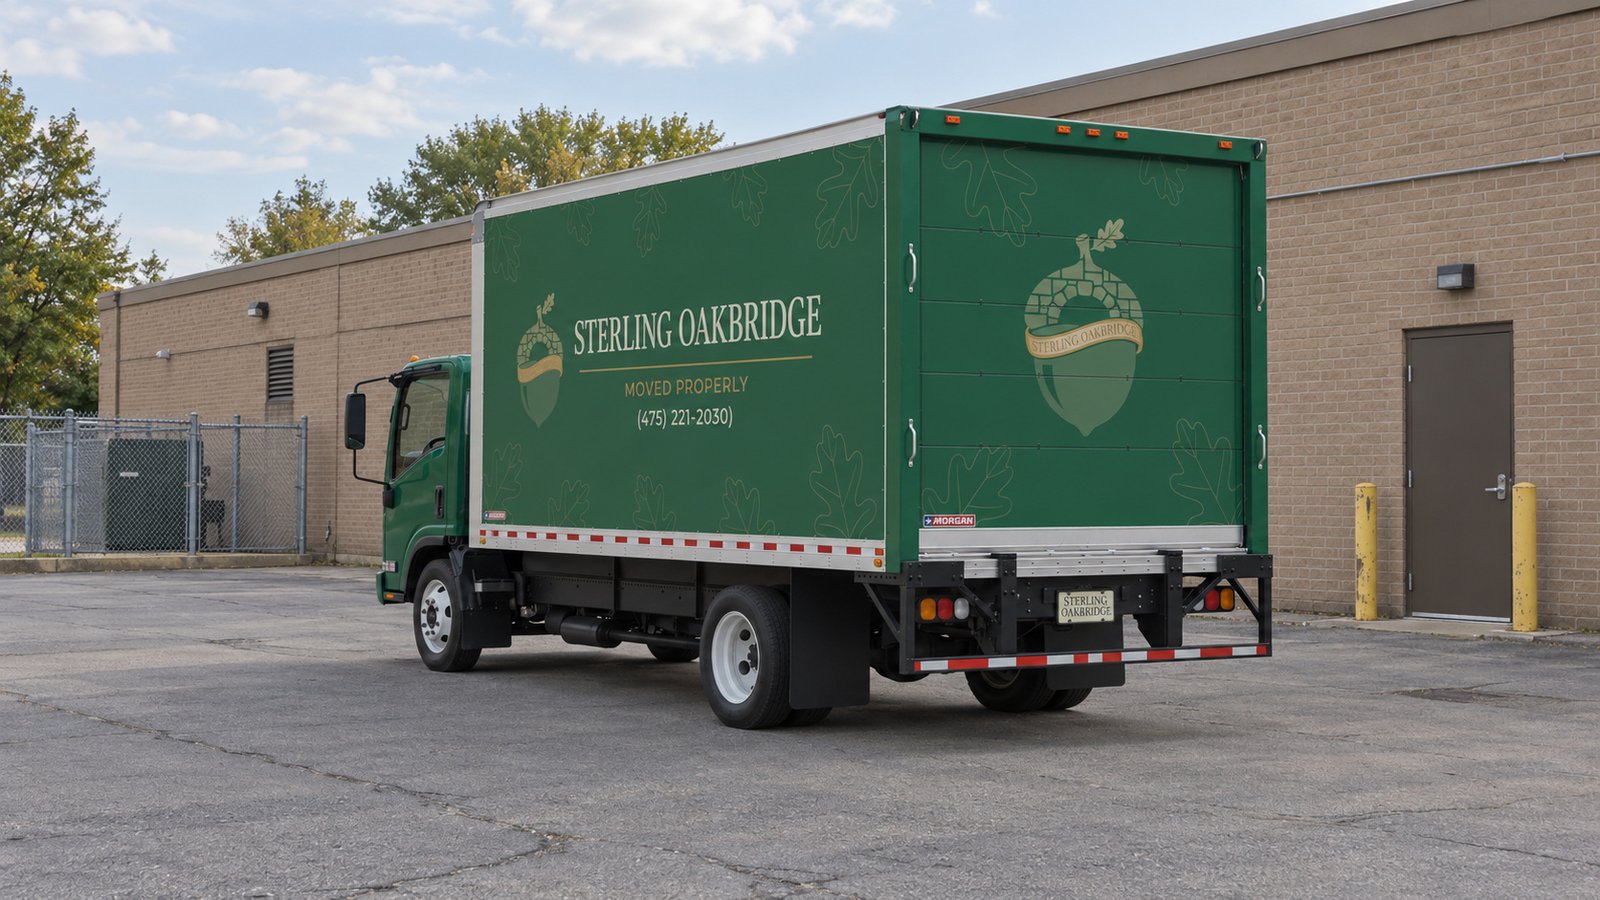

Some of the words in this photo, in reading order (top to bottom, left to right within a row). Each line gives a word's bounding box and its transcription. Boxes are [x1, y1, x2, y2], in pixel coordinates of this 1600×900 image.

[574, 310, 672, 355] STERLING
[679, 294, 822, 347] OAKBRIDGE
[1032, 334, 1079, 353] STERLING
[625, 380, 672, 398] MOVED
[676, 375, 749, 395] PROPERLY
[637, 408, 667, 430] (475)
[671, 406, 733, 428] 221-2030)
[932, 516, 974, 525] MORGAN
[1063, 595, 1108, 606] STERLING
[1060, 606, 1112, 617] OAKBRIDGE
